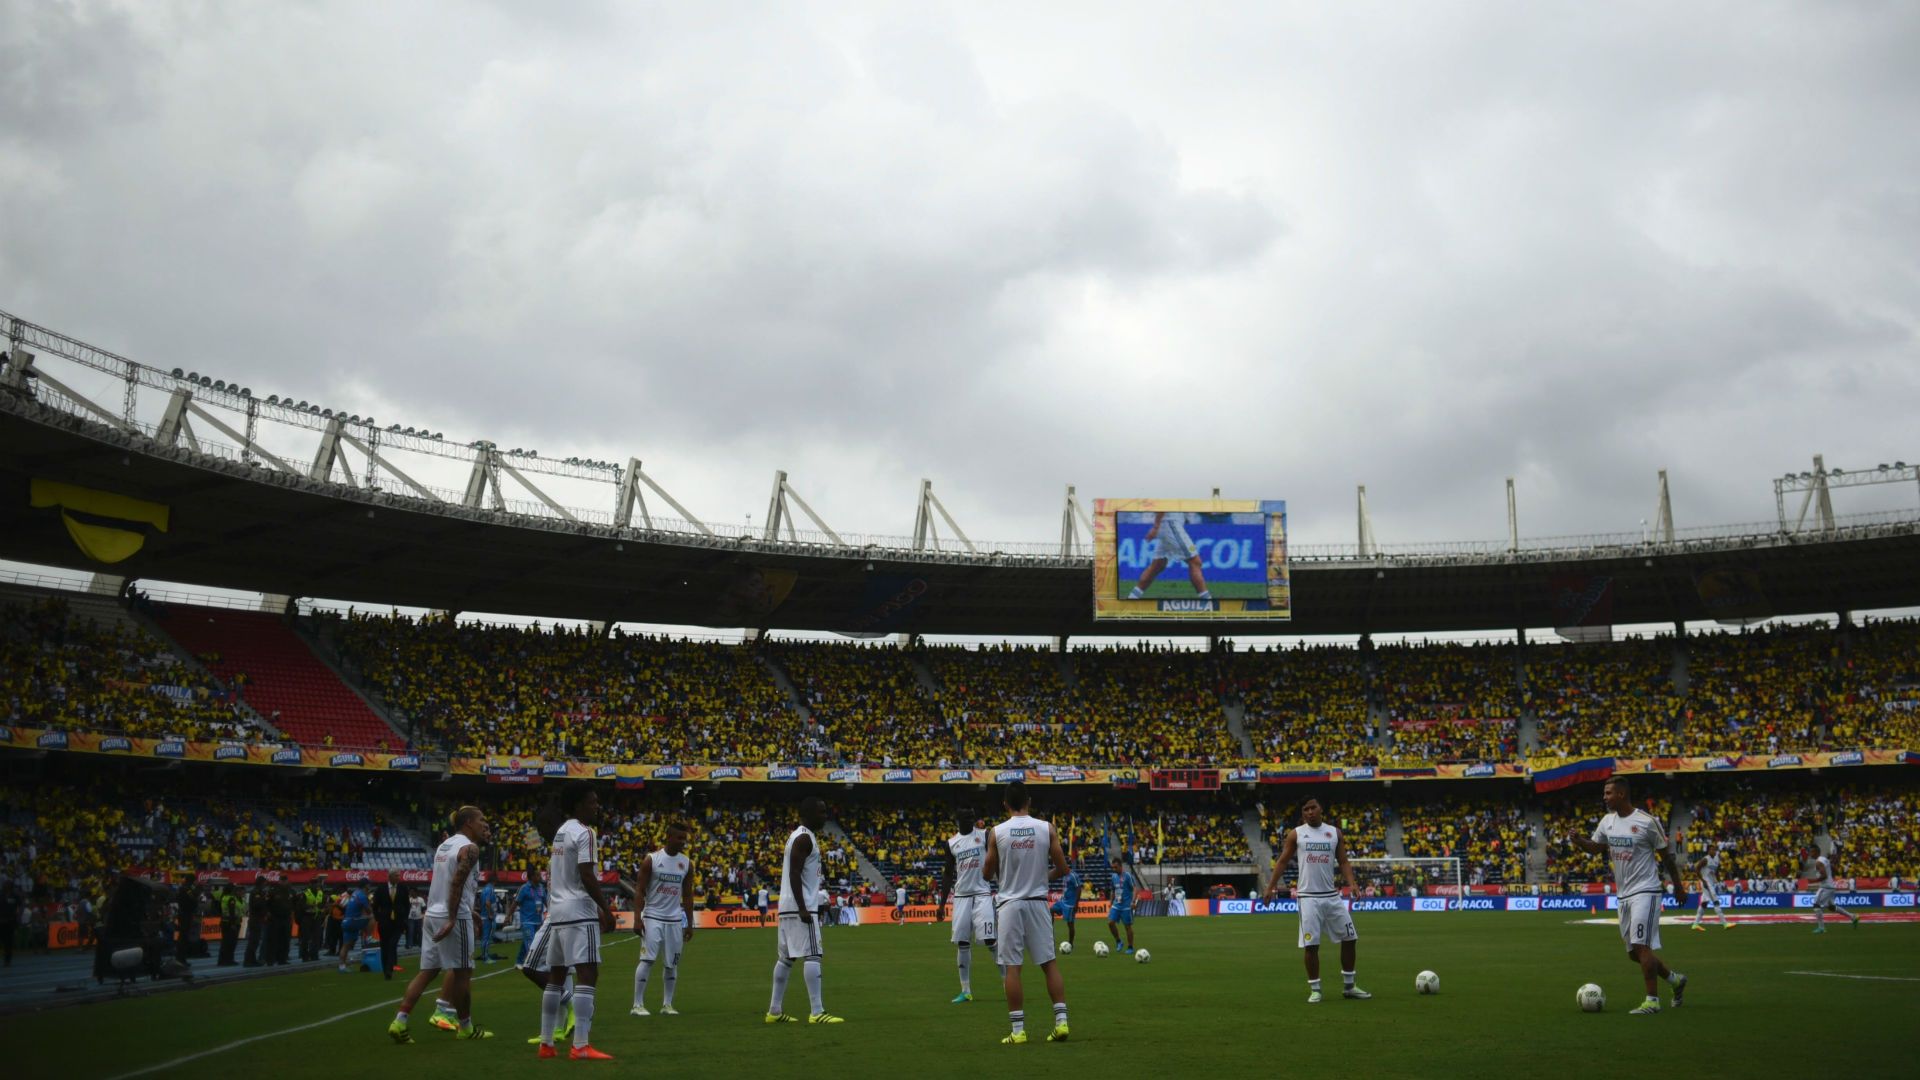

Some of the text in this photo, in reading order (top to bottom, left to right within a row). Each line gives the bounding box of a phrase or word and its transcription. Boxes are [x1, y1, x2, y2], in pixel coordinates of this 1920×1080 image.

[1117, 538, 1259, 569] ARCOL
[1162, 599, 1214, 611] AGUILA
[39, 732, 67, 746] AGUILA
[101, 737, 129, 752] AGUILA
[156, 742, 183, 754] AGUILA
[216, 746, 244, 758] AGUILA
[273, 749, 300, 762] AGUILA
[332, 754, 361, 766] AGUILA
[1832, 753, 1862, 764] AGUILA
[391, 756, 418, 768] AGUILA
[1770, 756, 1799, 767] AGUILA
[654, 766, 681, 778] AGUILA
[711, 768, 739, 779] AGUILA
[770, 767, 797, 779] AGUILA
[885, 770, 911, 781] AGUILA
[942, 771, 968, 781] AGUILA
[996, 770, 1024, 782] AGUILA
[1345, 768, 1374, 779] AGUILA
[1465, 765, 1494, 776] AGUILA
[1011, 839, 1034, 849] Coca-Cola
[958, 849, 979, 859] AGUILA
[1306, 853, 1329, 863] Coca-Cola
[403, 871, 428, 881] Coca-Cola
[1422, 899, 1495, 909] GOL CARACOL
[1515, 898, 1587, 909] GOL CARACOL
[1734, 896, 1779, 906] CARACOL
[1834, 896, 1872, 905] ARACOL
[1891, 896, 1913, 905] GOL
[1227, 902, 1250, 912] GOL
[716, 912, 775, 926] Continenal
[891, 908, 949, 921] Continenl
[984, 922, 993, 935] 13
[1345, 922, 1354, 937] 15
[1637, 923, 1644, 938] 8
